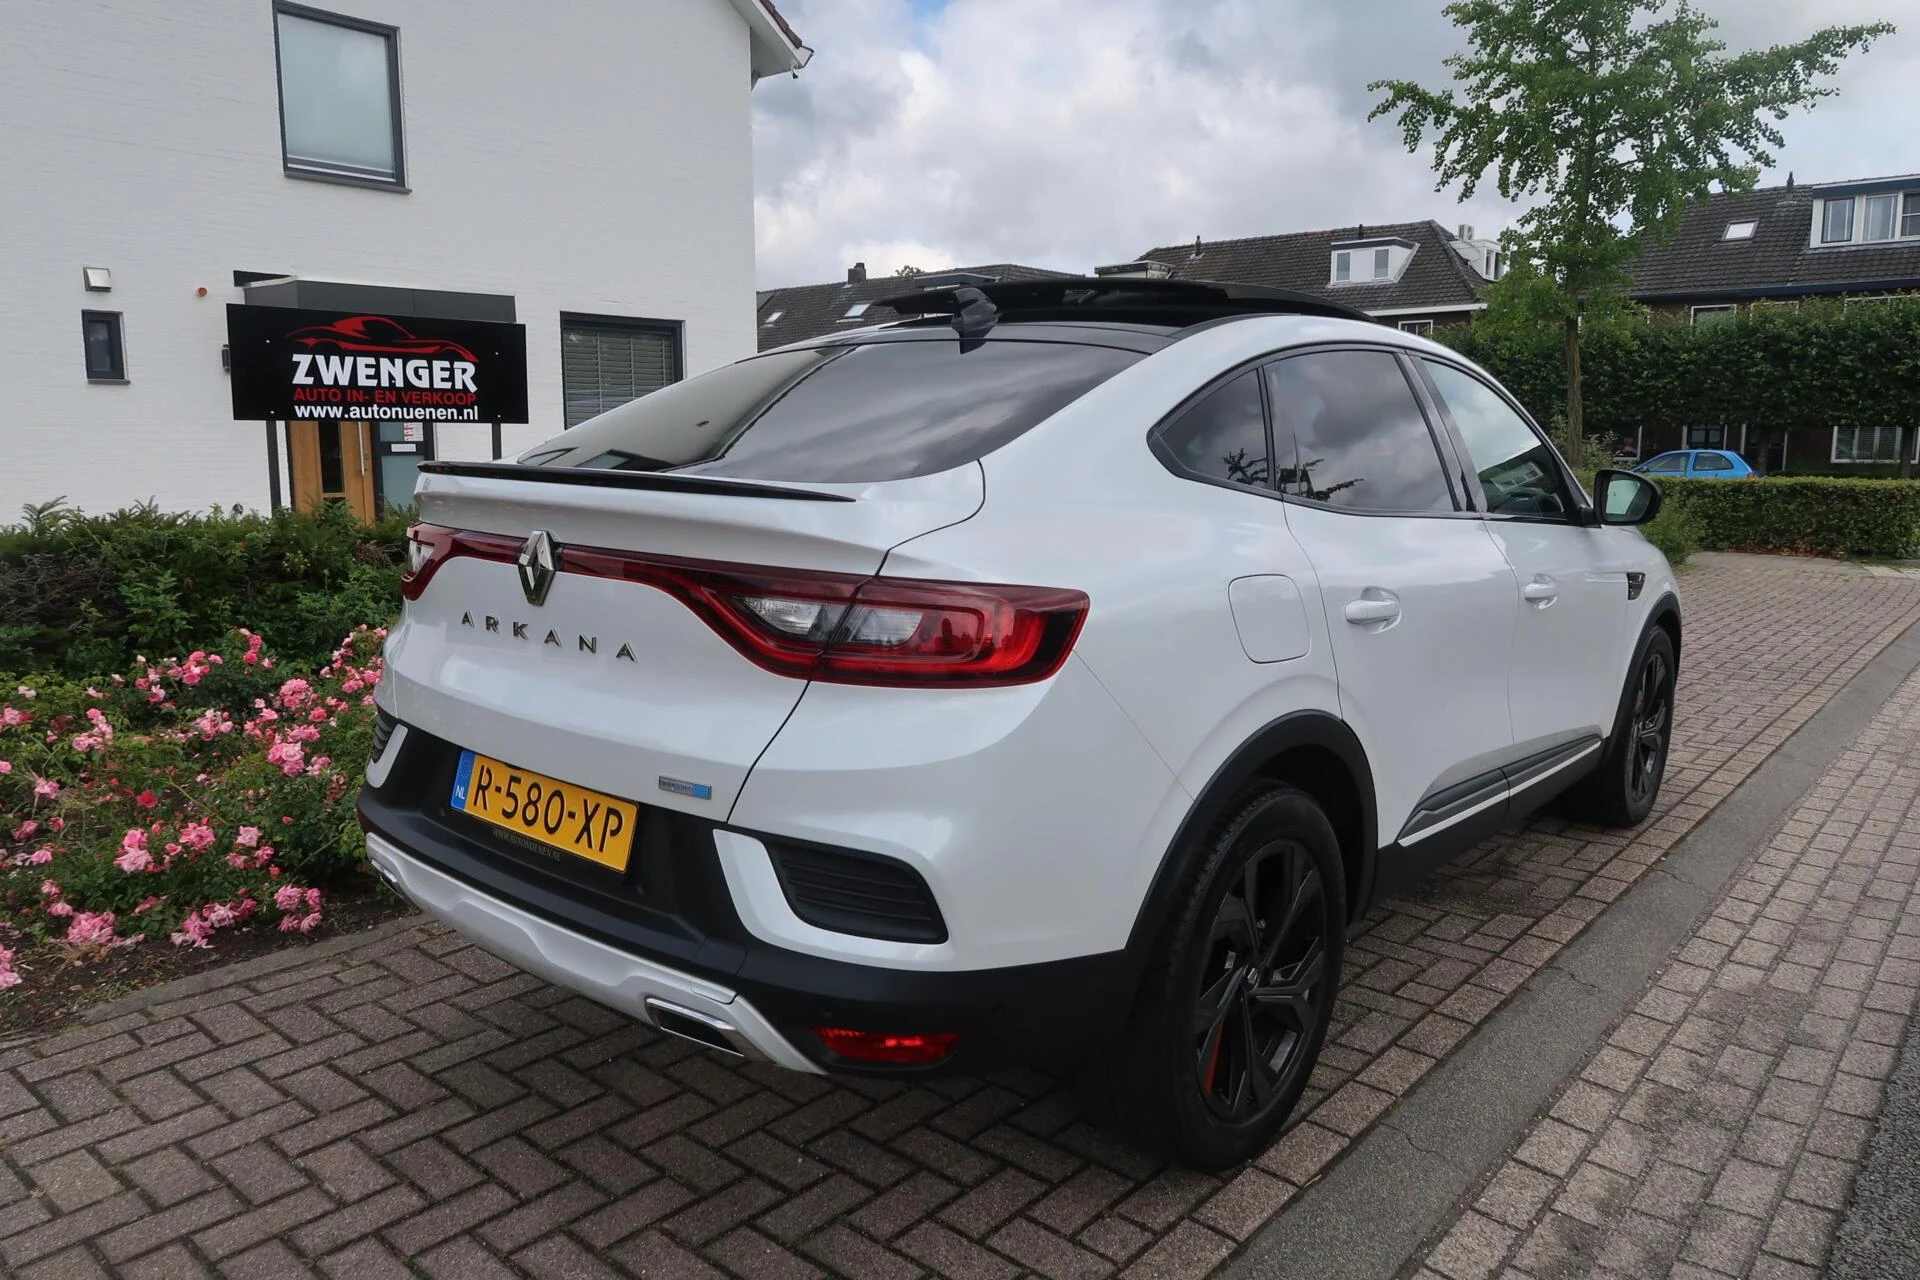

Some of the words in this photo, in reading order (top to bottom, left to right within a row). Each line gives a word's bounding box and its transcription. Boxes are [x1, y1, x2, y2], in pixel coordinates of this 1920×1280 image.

[292, 354, 478, 393] ZWENGER
[294, 388, 341, 403] AUTO
[347, 390, 369, 403] IN-
[376, 390, 397, 404] EN
[400, 391, 477, 406] VERKOOP
[295, 404, 478, 420] www.autonuenen.nl
[461, 609, 638, 662] ARKANA
[455, 785, 467, 801] NL
[473, 765, 624, 853] R-580-XP
